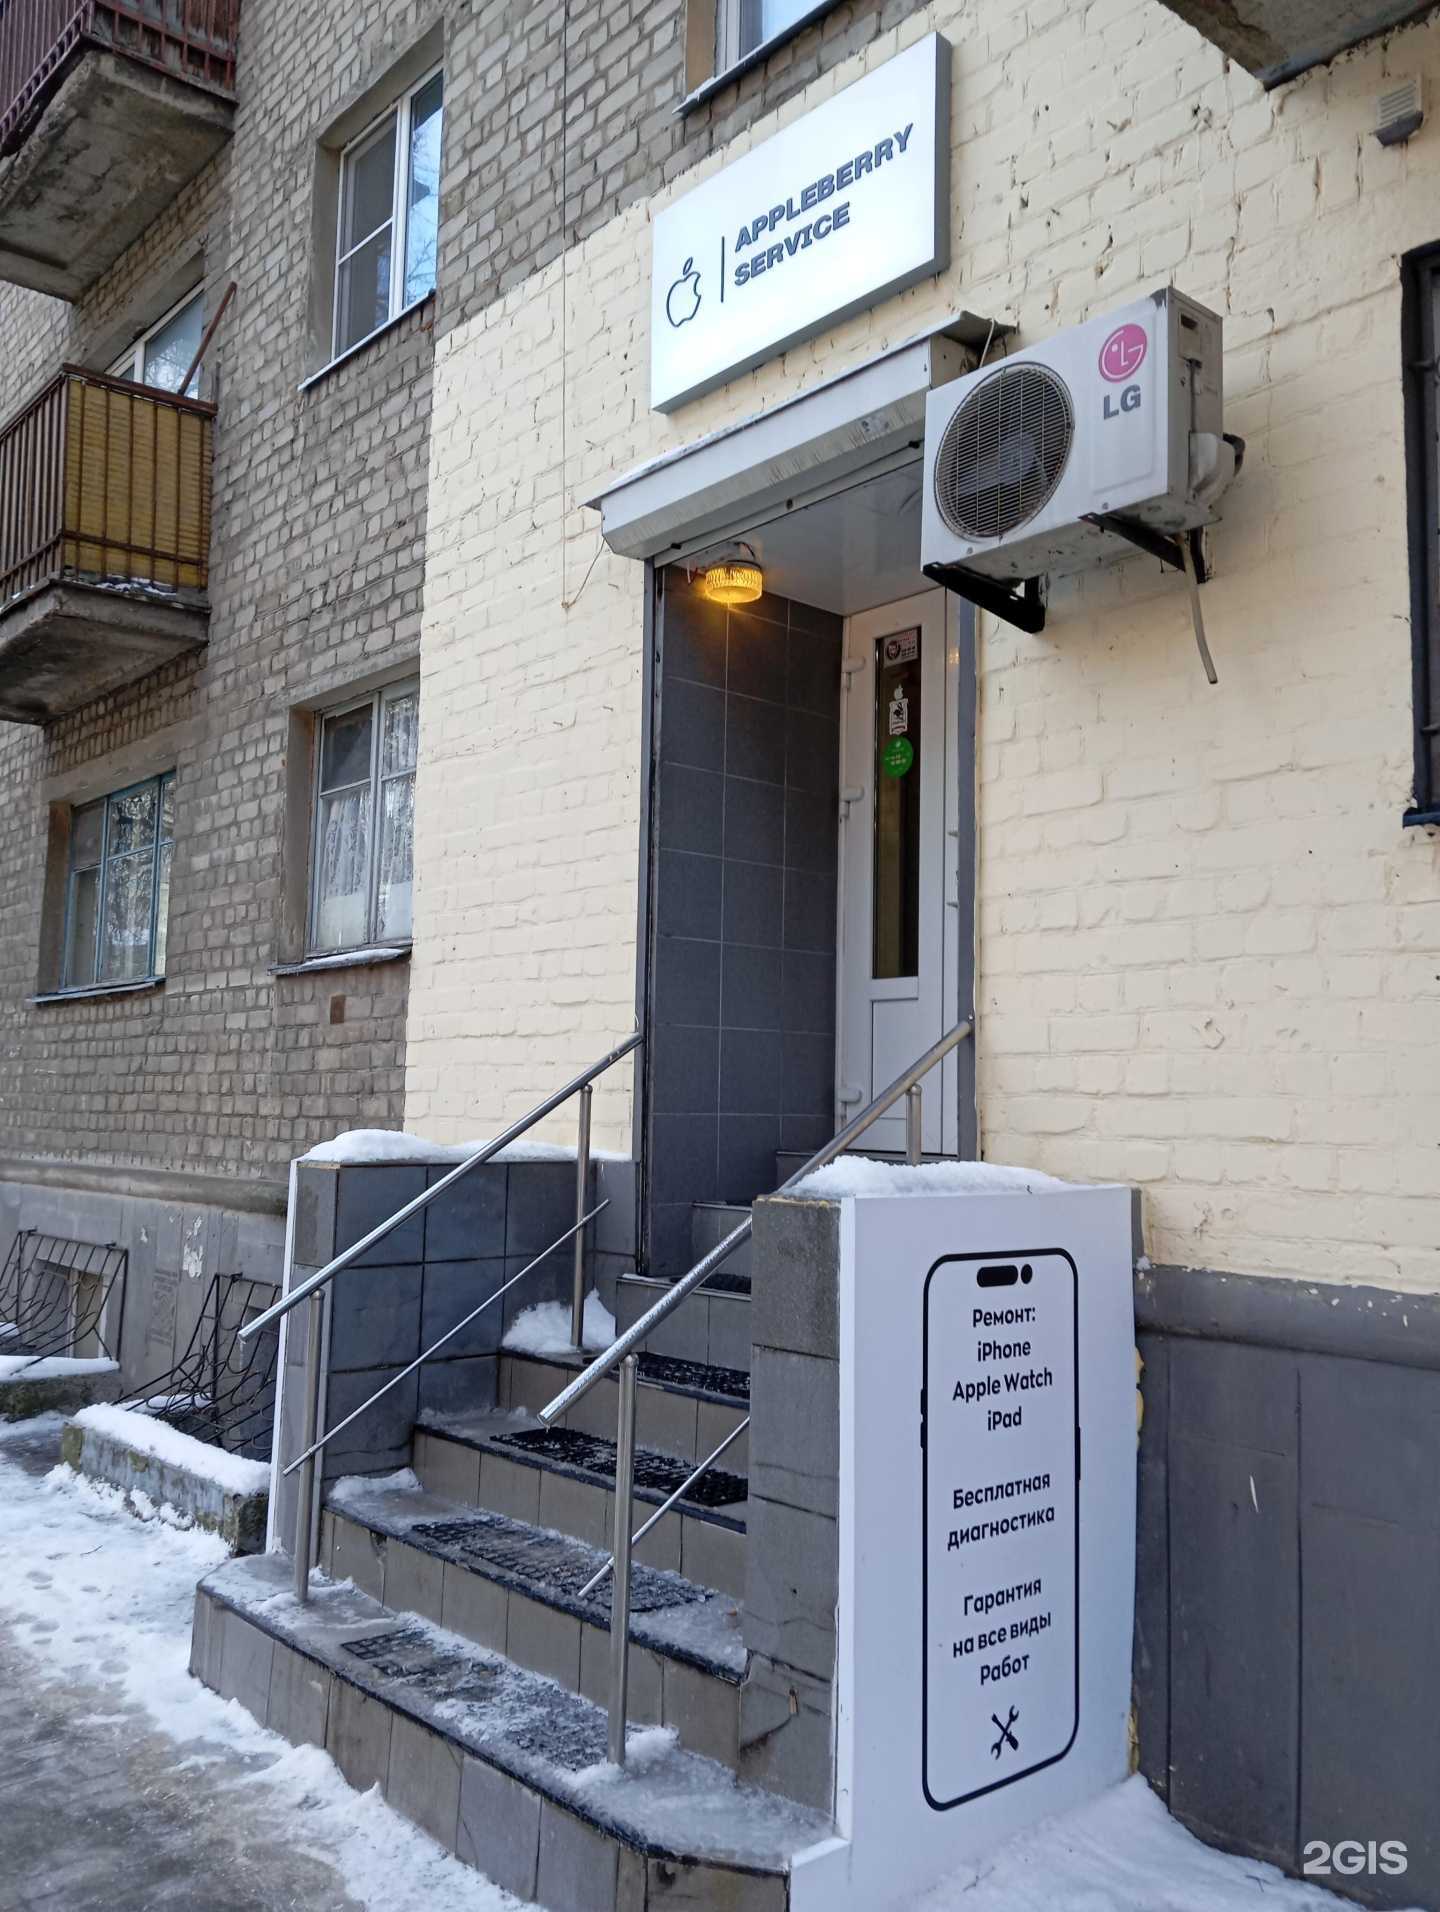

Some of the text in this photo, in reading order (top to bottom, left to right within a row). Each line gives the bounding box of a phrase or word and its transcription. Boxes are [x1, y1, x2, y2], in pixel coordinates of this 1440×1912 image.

[735, 122, 914, 253] APPLEBERRY
[734, 201, 850, 287] SERVICE
[1103, 384, 1142, 420] LG
[972, 1307, 1037, 1328] Ремонт:
[977, 1340, 1032, 1362] iPhone
[952, 1367, 1053, 1403] Apple Watch
[987, 1406, 1023, 1431] iPad
[952, 1473, 1051, 1509] Бесплатная
[947, 1506, 1055, 1551] диагностика
[963, 1578, 1042, 1616] Гарантия
[952, 1611, 1052, 1658] на все виды
[979, 1653, 1030, 1686] Работ
